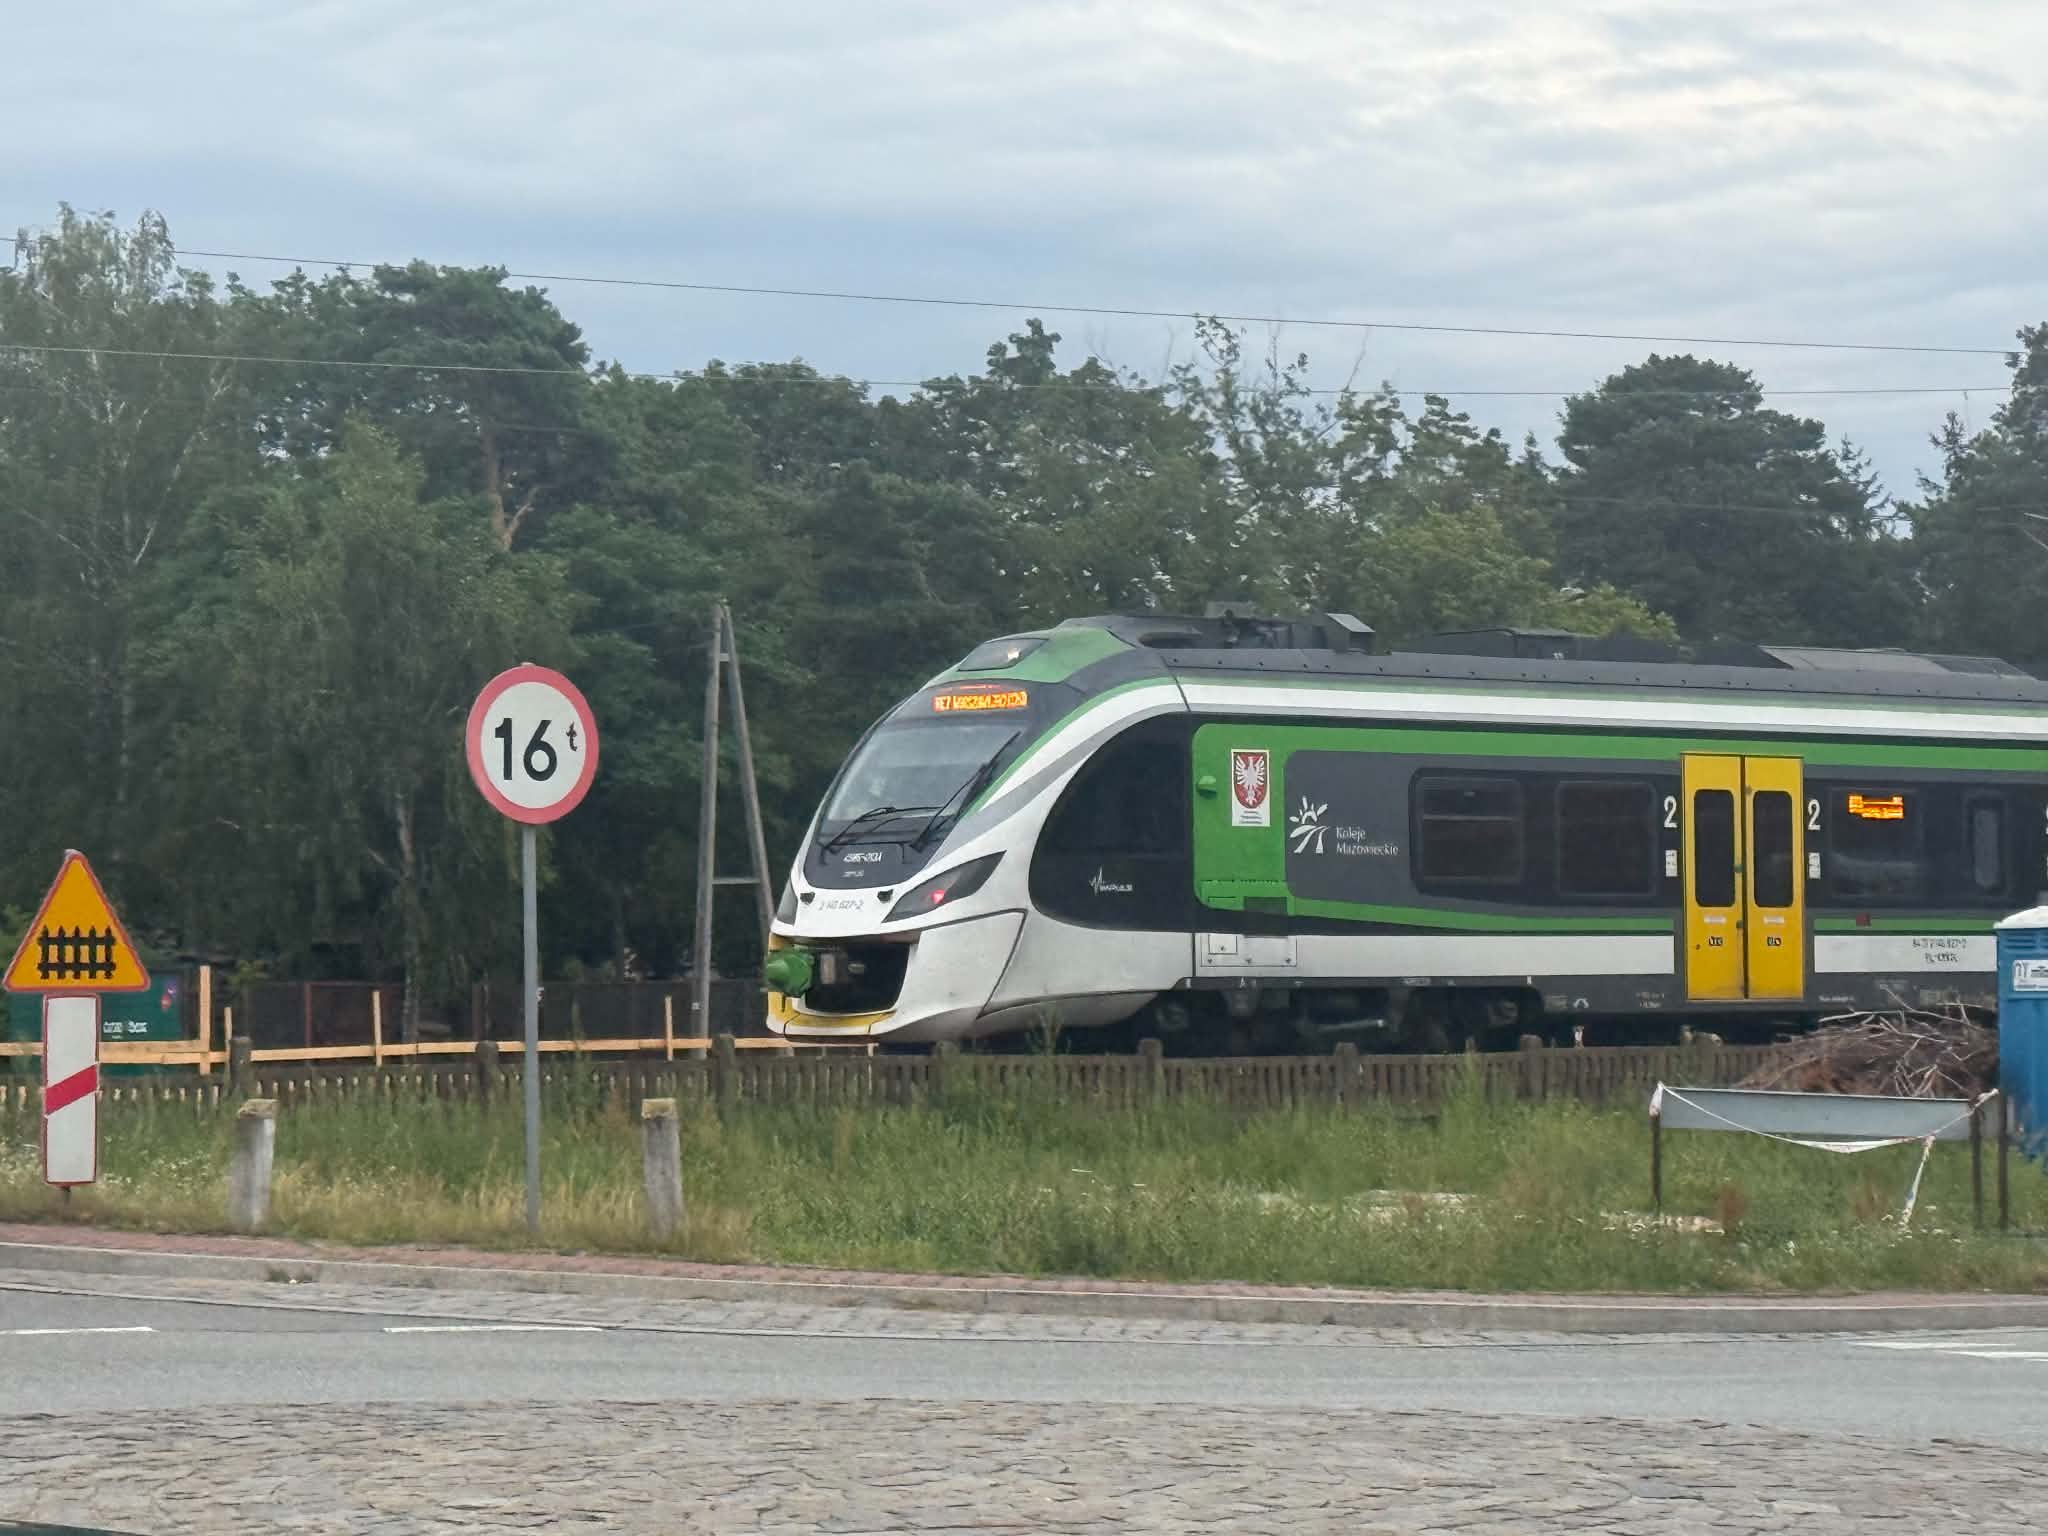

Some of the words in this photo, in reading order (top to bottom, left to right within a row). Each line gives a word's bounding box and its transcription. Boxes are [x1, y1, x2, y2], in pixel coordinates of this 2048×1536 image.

[495, 717, 557, 782] 16
[566, 721, 578, 752] t
[1663, 795, 1678, 828] 2
[1807, 799, 1821, 831] 2
[1336, 826, 1366, 842] Koleje
[1336, 843, 1399, 856] Mazowieckie
